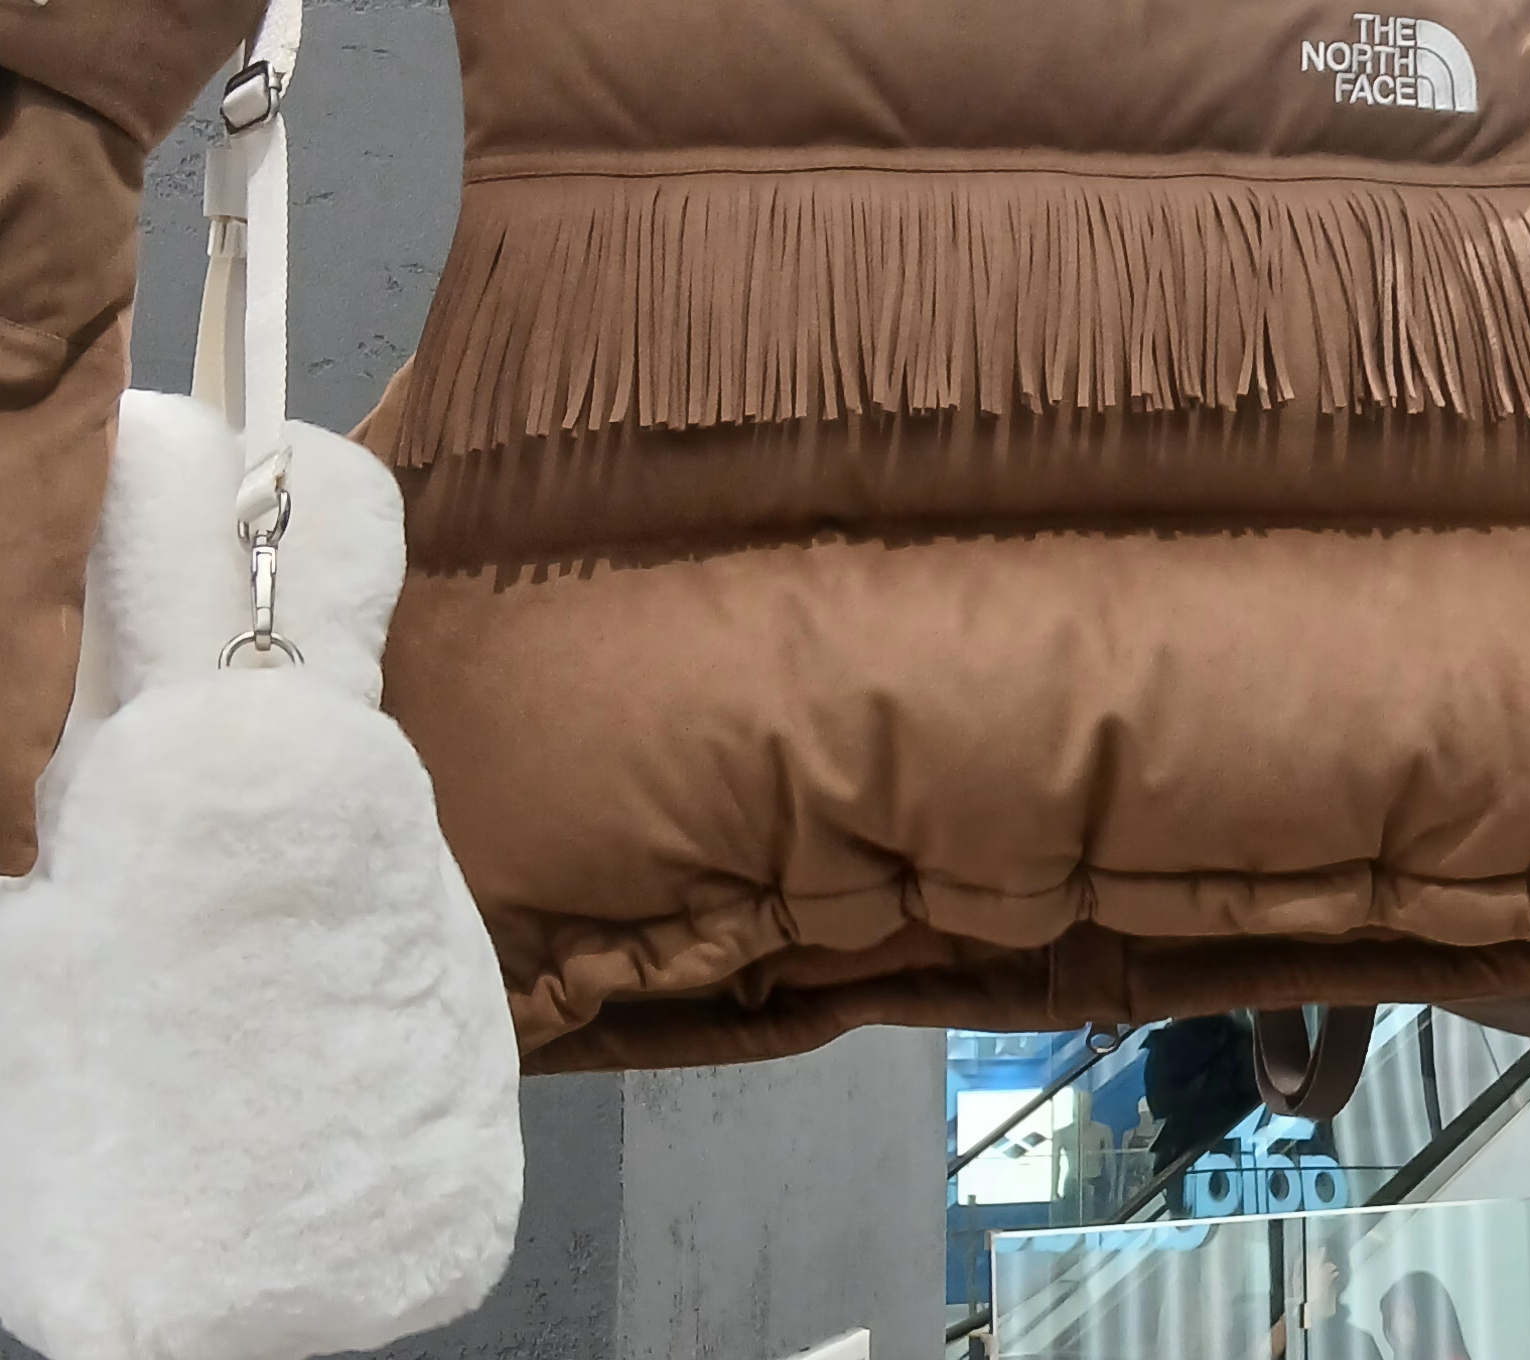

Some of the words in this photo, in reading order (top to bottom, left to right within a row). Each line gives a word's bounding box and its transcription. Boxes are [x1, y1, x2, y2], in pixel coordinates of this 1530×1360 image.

[1354, 13, 1416, 47] THE
[1301, 40, 1416, 78] NORTH
[1335, 72, 1417, 107] FACE
